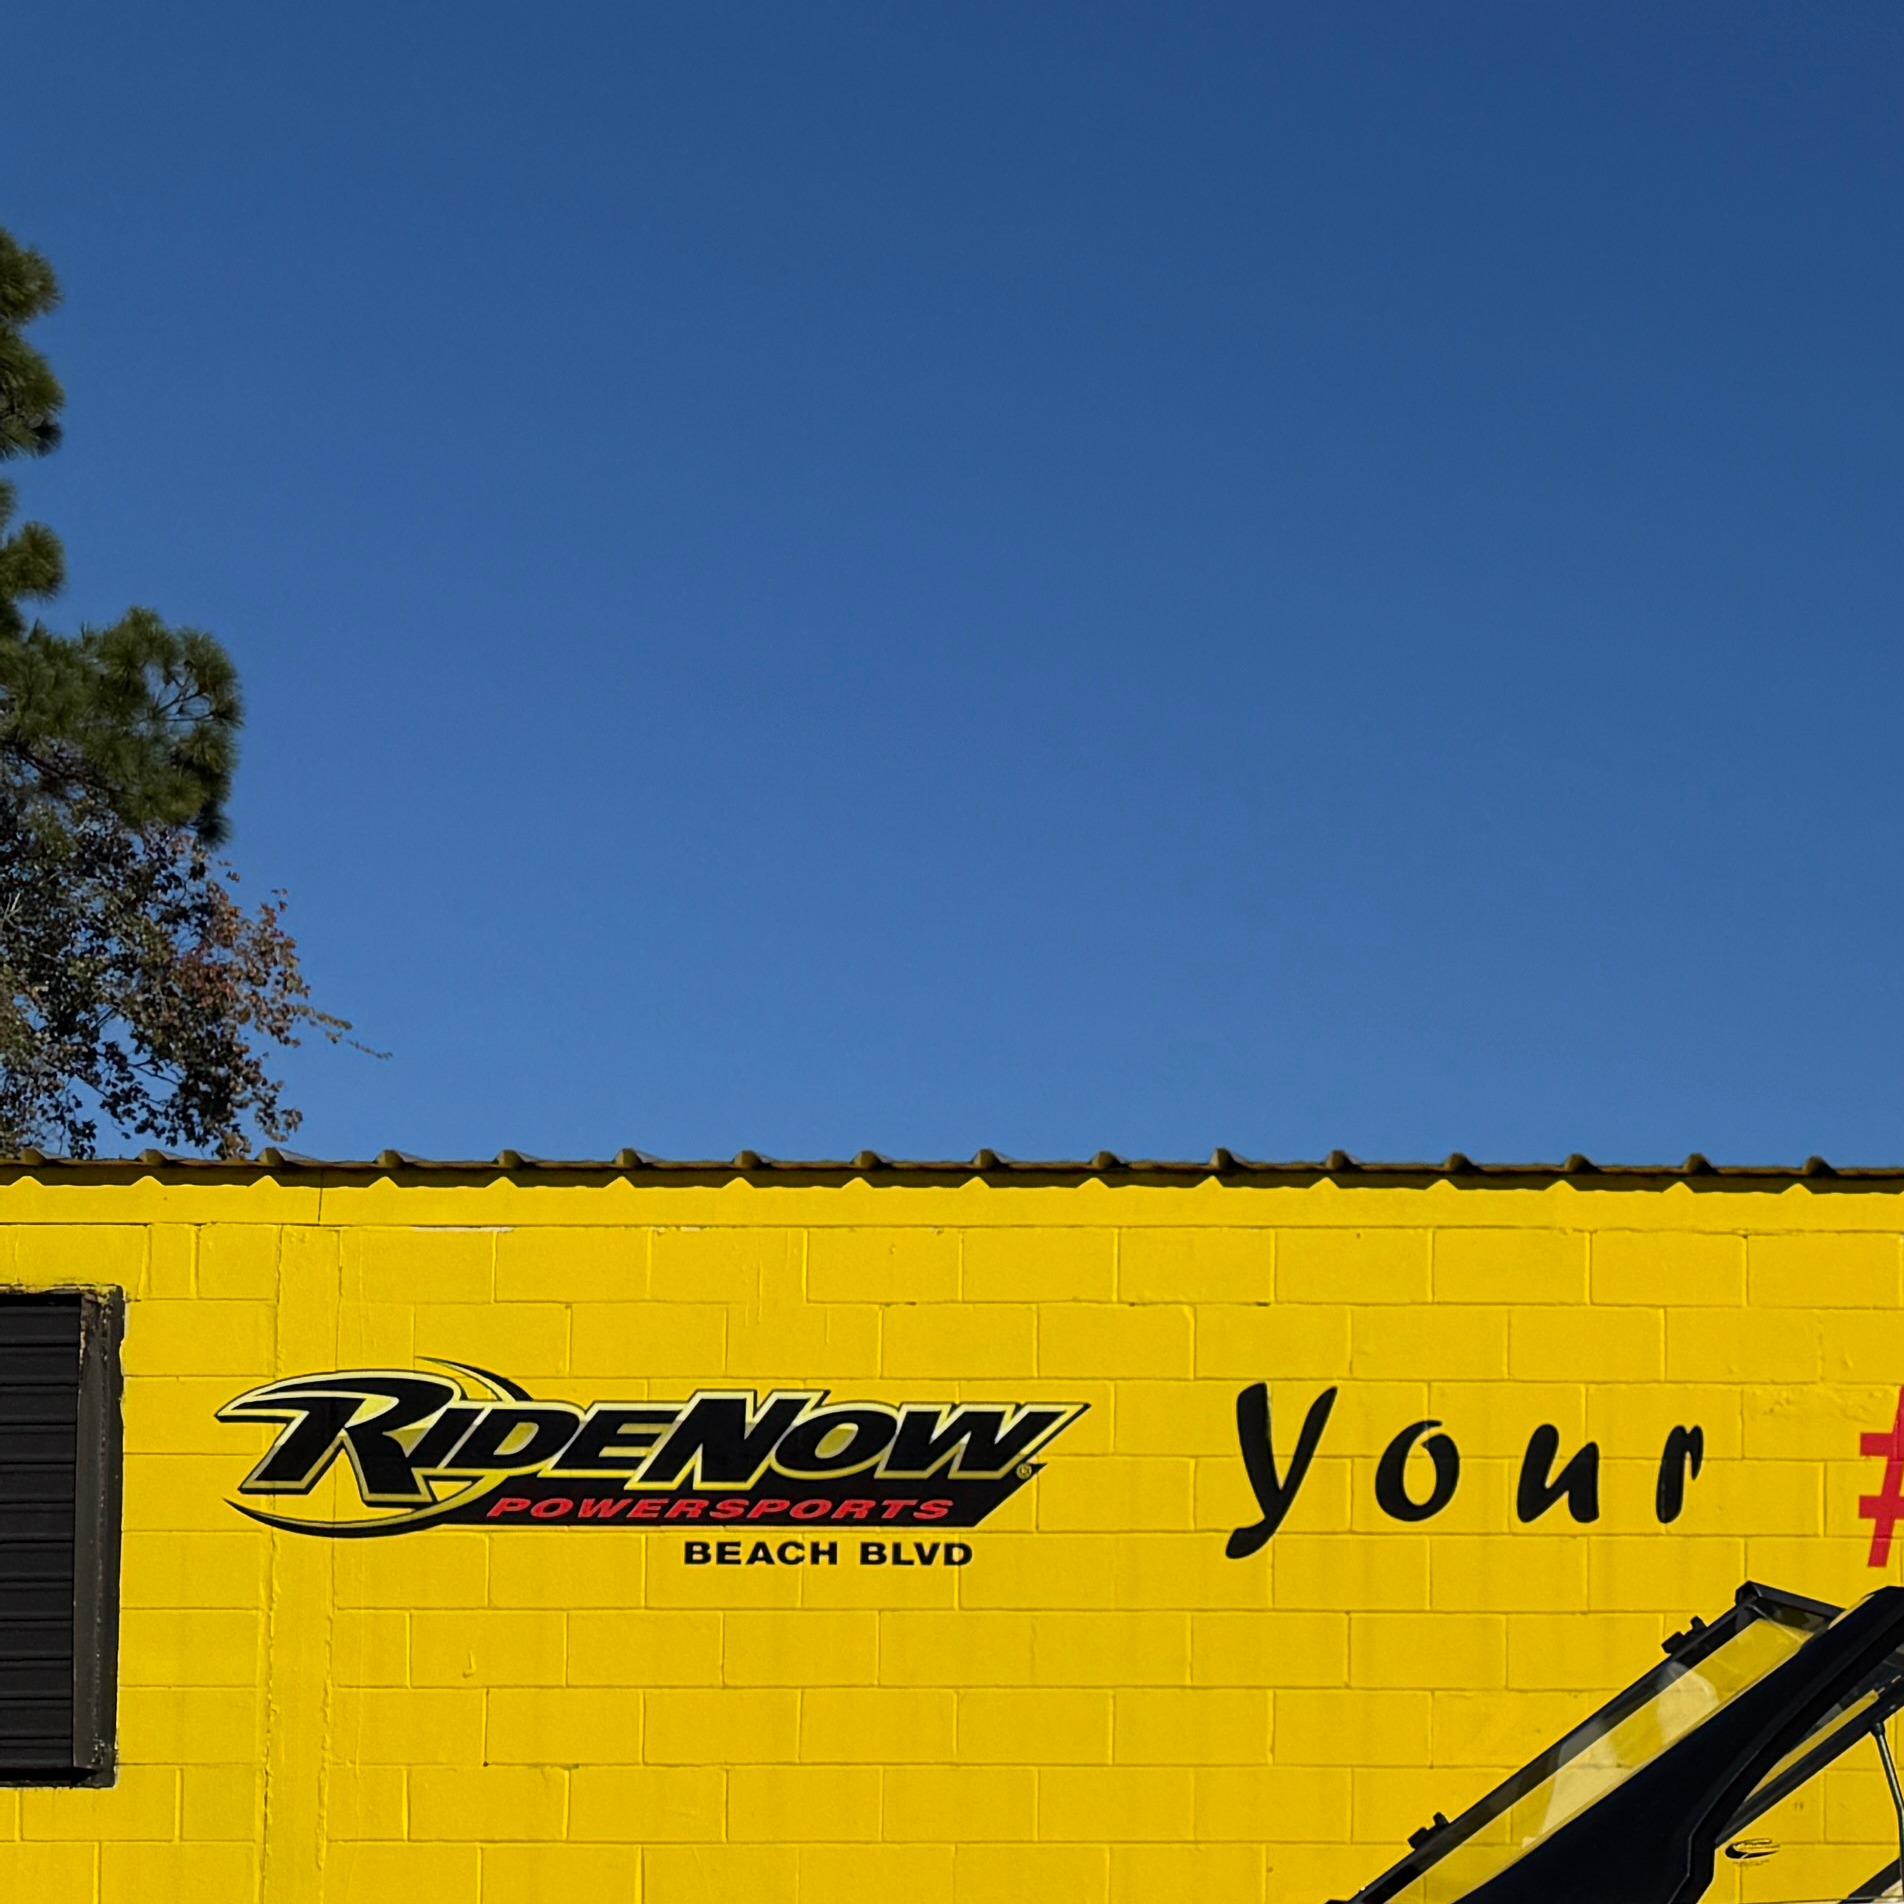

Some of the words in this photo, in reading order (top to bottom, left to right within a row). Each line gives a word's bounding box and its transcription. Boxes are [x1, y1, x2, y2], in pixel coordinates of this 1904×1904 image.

[1225, 1381, 1705, 1560] Your
[488, 1496, 954, 1520] POWERSPORTS
[683, 1541, 840, 1567] BEACH
[858, 1541, 974, 1567] BLVD
